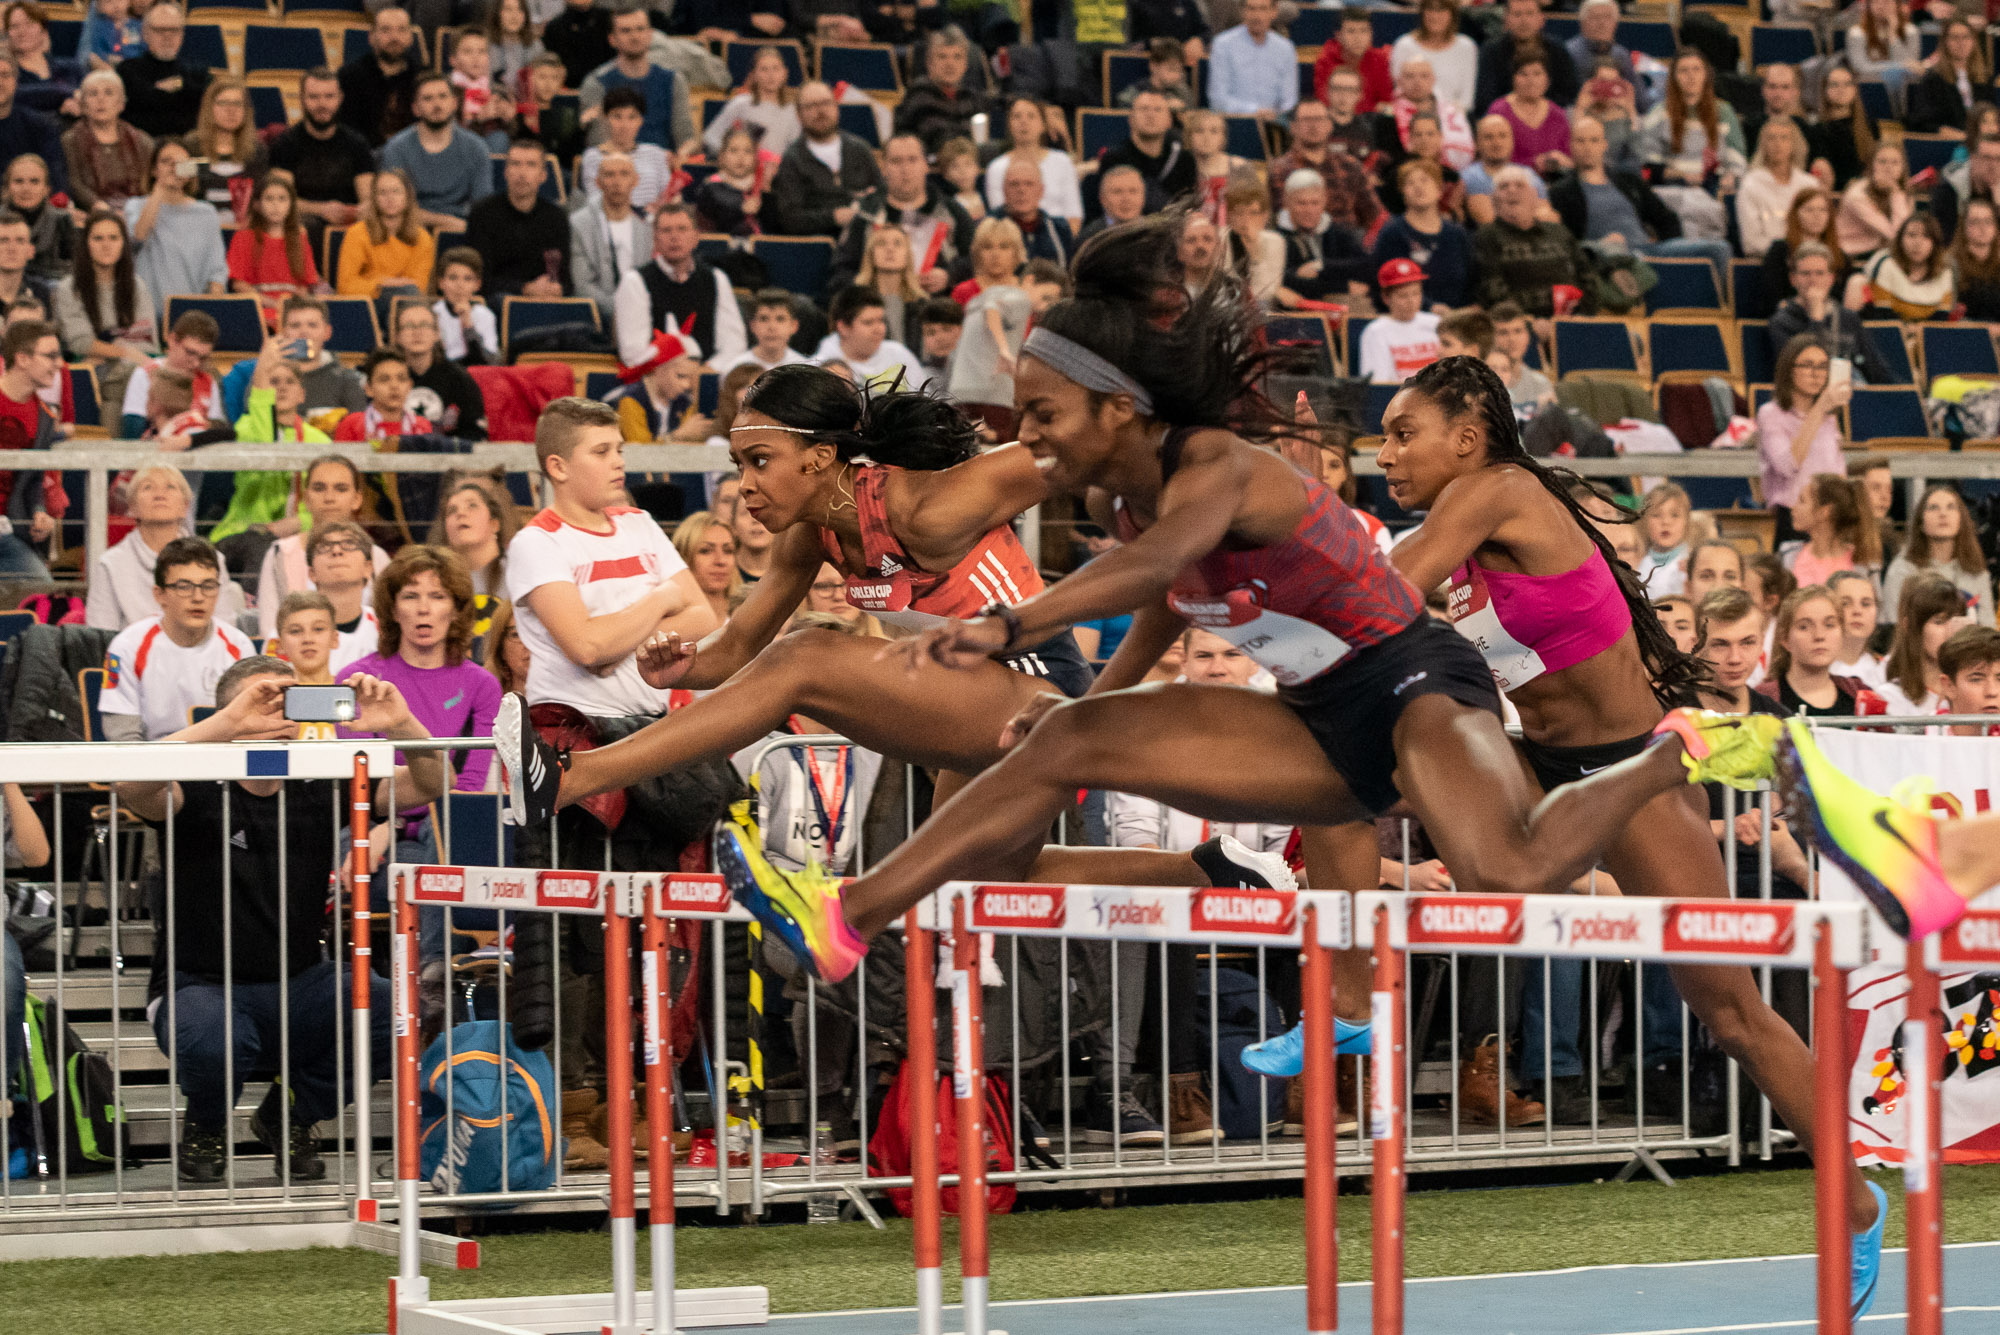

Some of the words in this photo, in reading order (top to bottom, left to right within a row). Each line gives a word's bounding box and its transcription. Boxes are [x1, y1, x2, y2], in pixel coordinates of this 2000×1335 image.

[881, 564, 903, 577] adidas
[850, 586, 876, 599] ORLEN
[875, 584, 893, 598] CUP
[1456, 584, 1472, 601] CUP
[421, 874, 446, 892] ORLEN
[446, 875, 463, 892] CUP
[492, 878, 527, 901] polanik
[543, 878, 574, 898] ORLEN
[574, 880, 591, 899] CUP
[669, 881, 703, 902] ORLEN
[703, 883, 723, 903] CUP
[983, 893, 1028, 918] ORLEN
[1028, 895, 1054, 918] CUP
[1108, 898, 1166, 929] polanik
[1202, 896, 1254, 922] ORLEN
[1253, 898, 1283, 925] CUP
[1420, 904, 1476, 932] ORLEN
[1476, 905, 1508, 933] CUP
[1570, 912, 1641, 947] polanik
[1677, 911, 1741, 942] ORLEN
[1741, 912, 1777, 944] CUP
